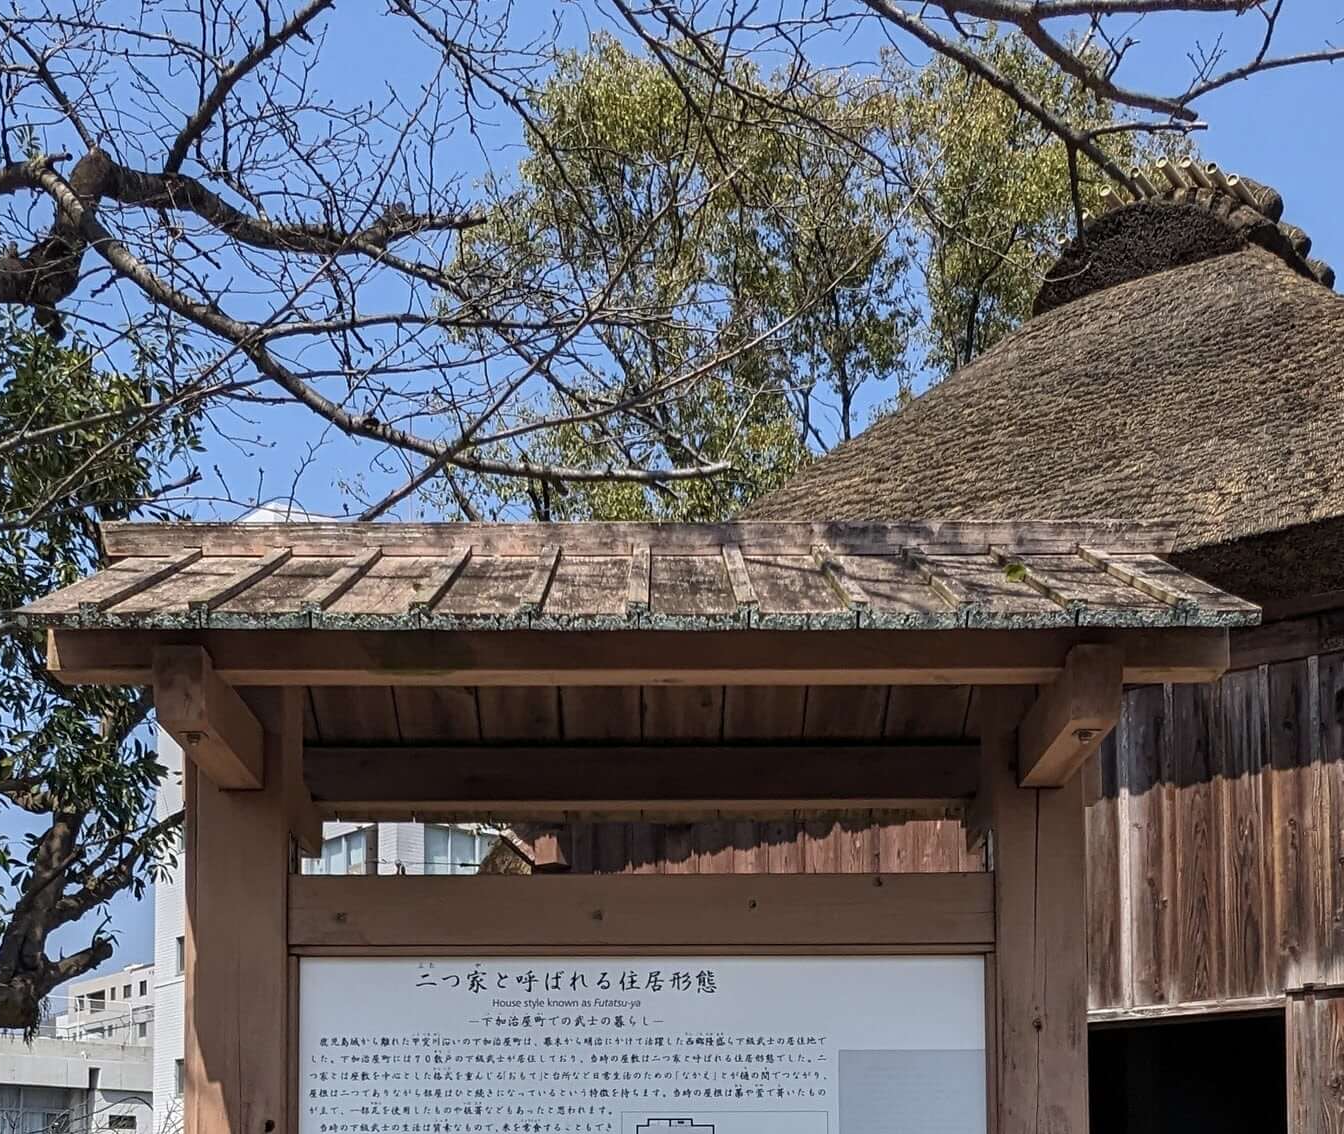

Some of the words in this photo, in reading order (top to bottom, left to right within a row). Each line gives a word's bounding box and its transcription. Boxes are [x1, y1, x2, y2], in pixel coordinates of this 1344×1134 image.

[415, 969, 718, 994] 二つ家と呼ばれる住居形態
[492, 997, 521, 1008] House
[524, 997, 544, 1010] style
[547, 997, 578, 1008] known
[594, 997, 641, 1010] Futatsu-ya
